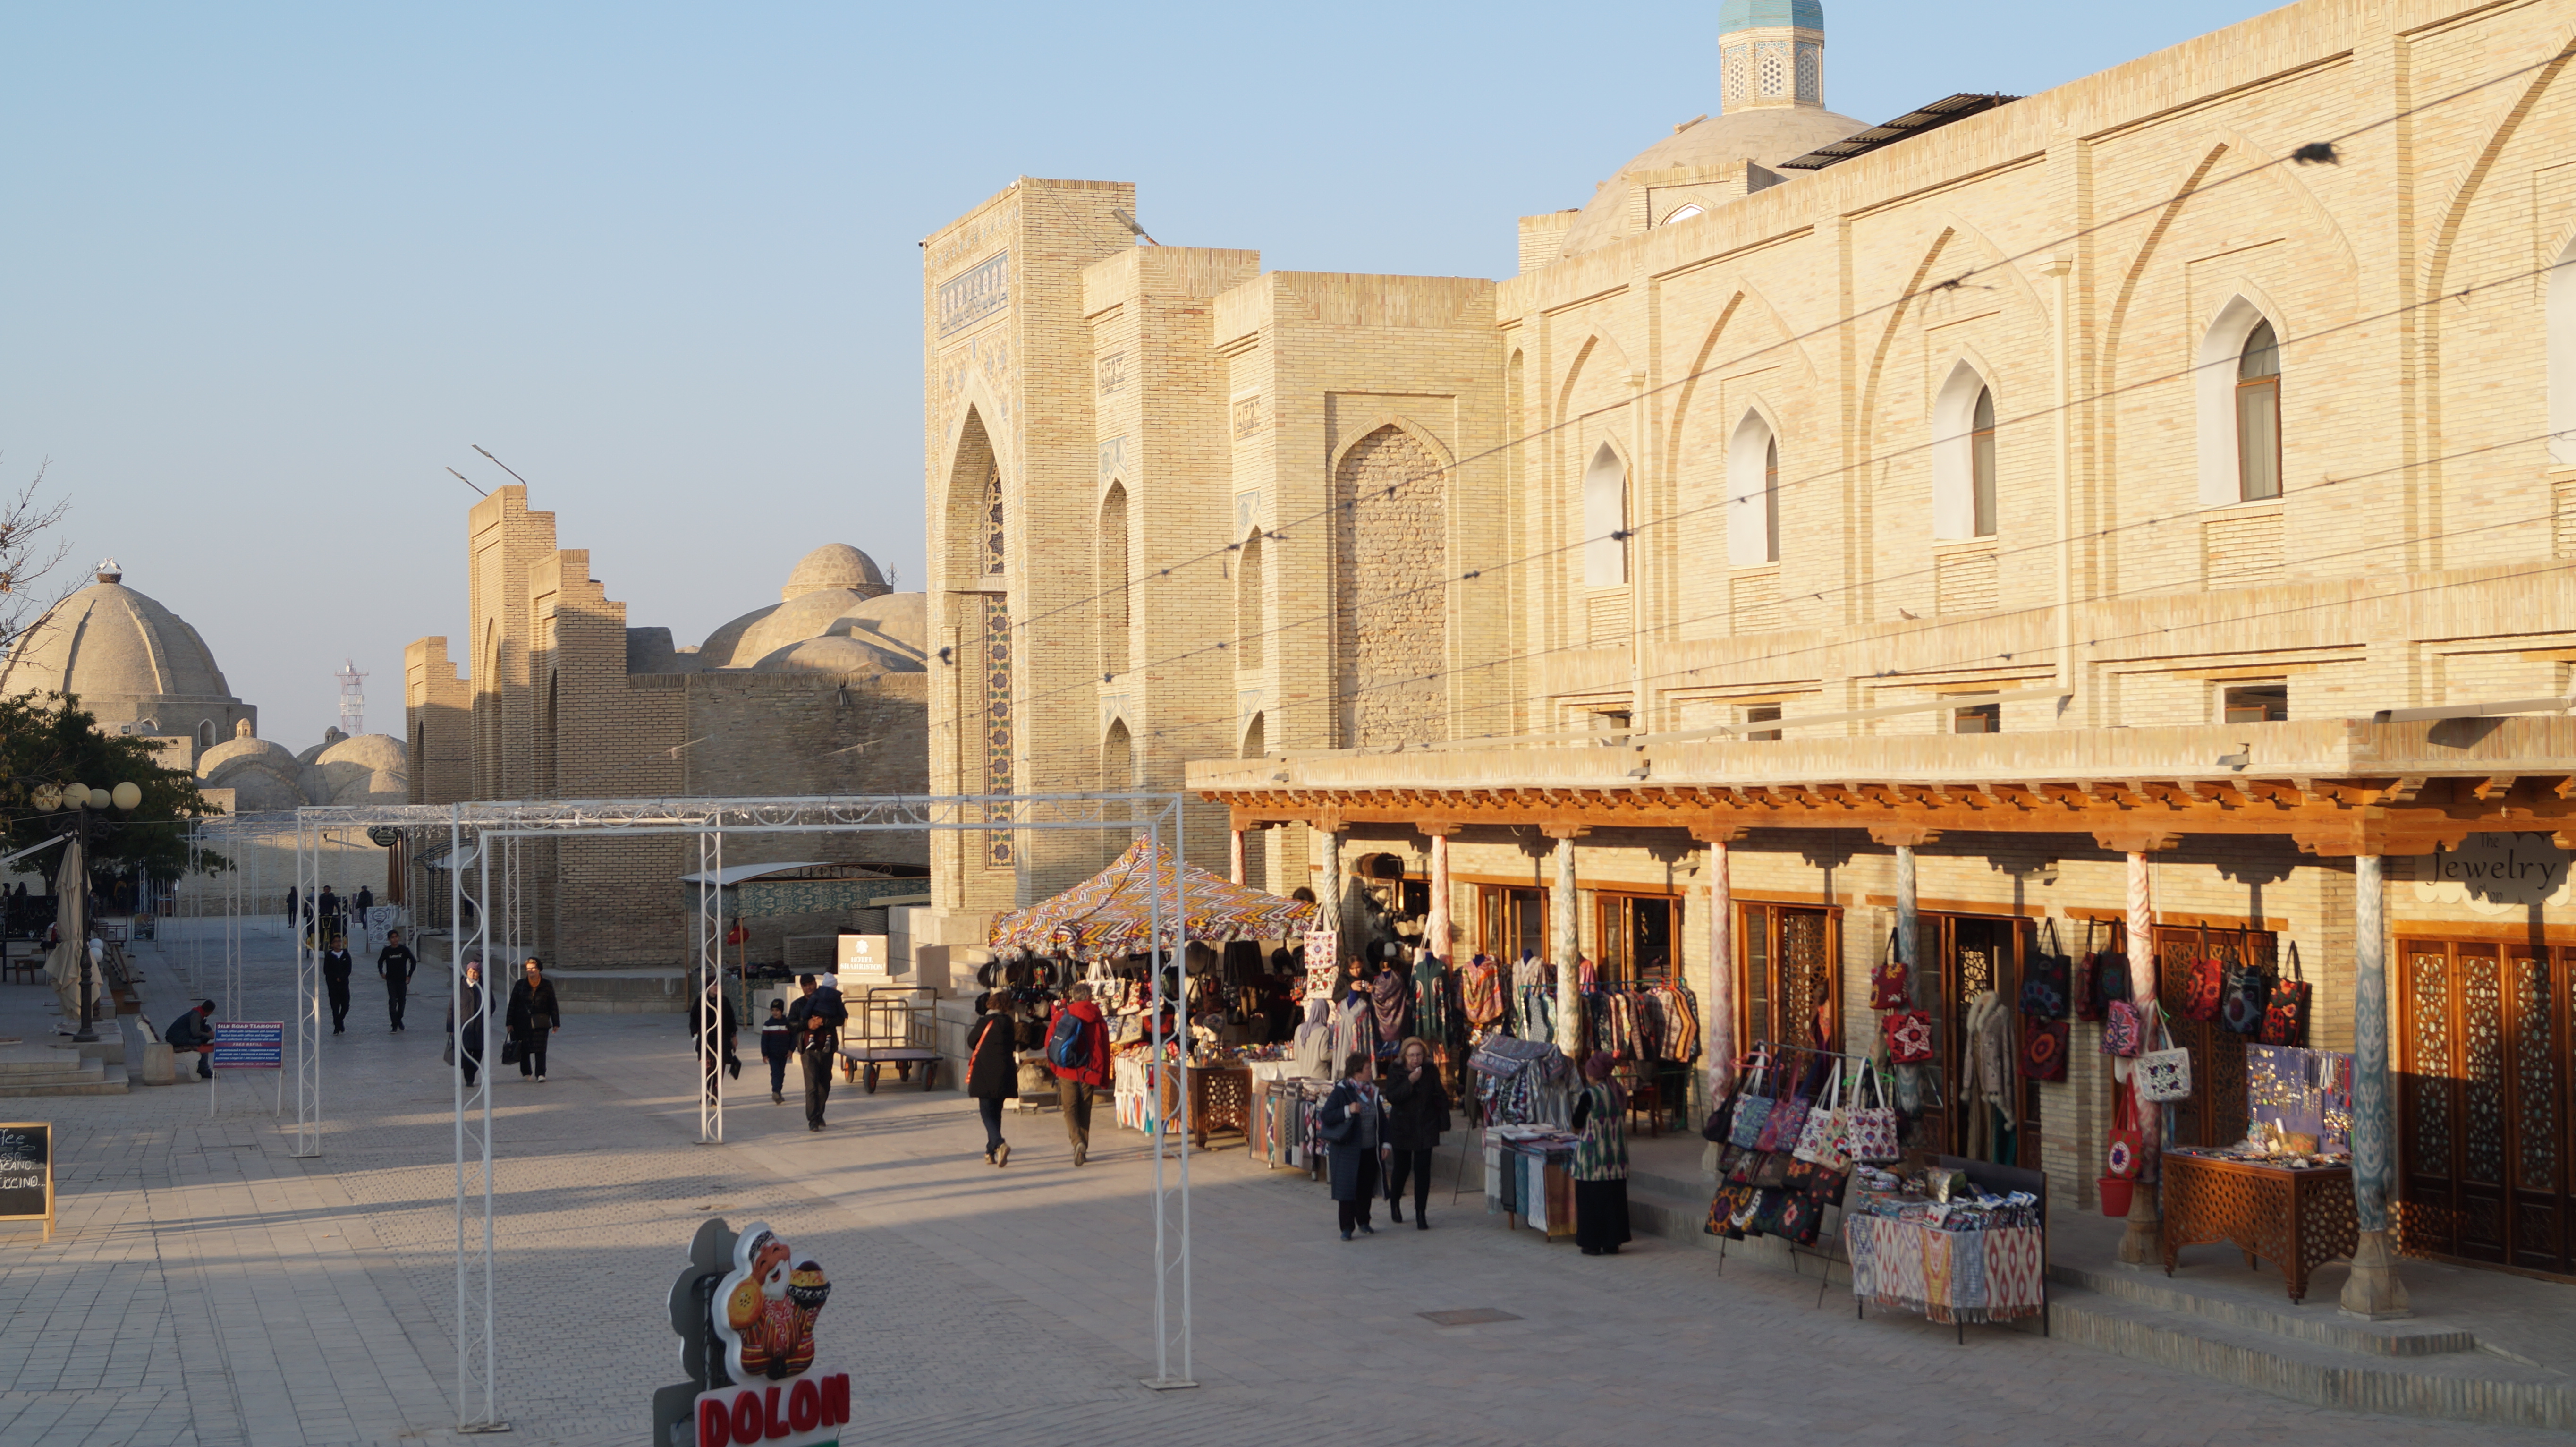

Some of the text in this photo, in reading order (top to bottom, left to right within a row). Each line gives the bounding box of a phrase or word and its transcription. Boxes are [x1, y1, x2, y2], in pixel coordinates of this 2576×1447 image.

[2480, 833, 2499, 848] The
[2425, 848, 2557, 890] Jewelry
[2476, 883, 2502, 907] Shop
[700, 1372, 849, 1447] DOLON
